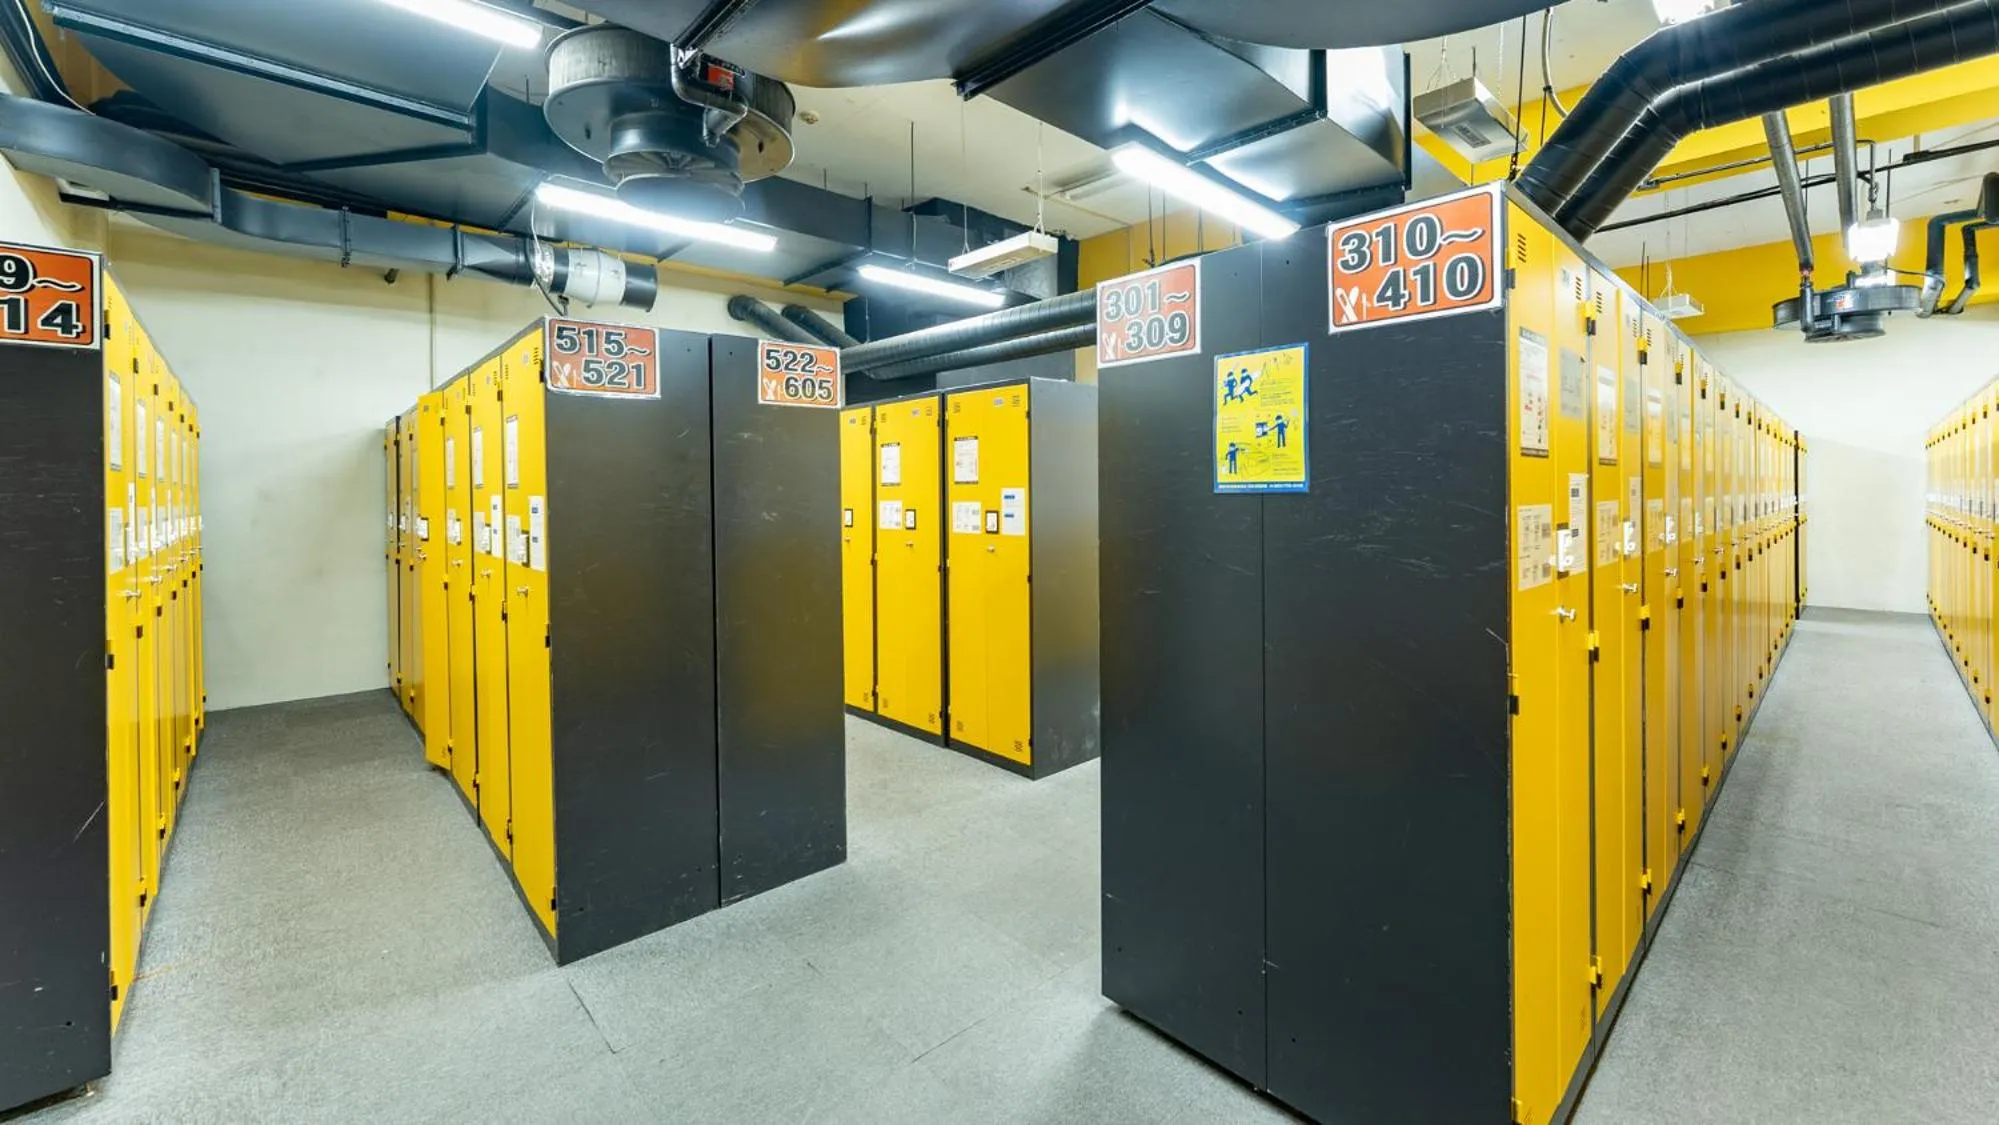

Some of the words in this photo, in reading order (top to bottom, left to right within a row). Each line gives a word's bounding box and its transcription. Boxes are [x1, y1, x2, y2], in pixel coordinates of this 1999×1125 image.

[1338, 214, 1485, 274] 310~
[1373, 253, 1484, 311] 410
[1104, 280, 1191, 322] 301~
[555, 325, 652, 358] 515~
[1125, 311, 1189, 353] 309
[581, 357, 645, 389] 521
[765, 347, 834, 376] 522~
[784, 375, 833, 402] 605
